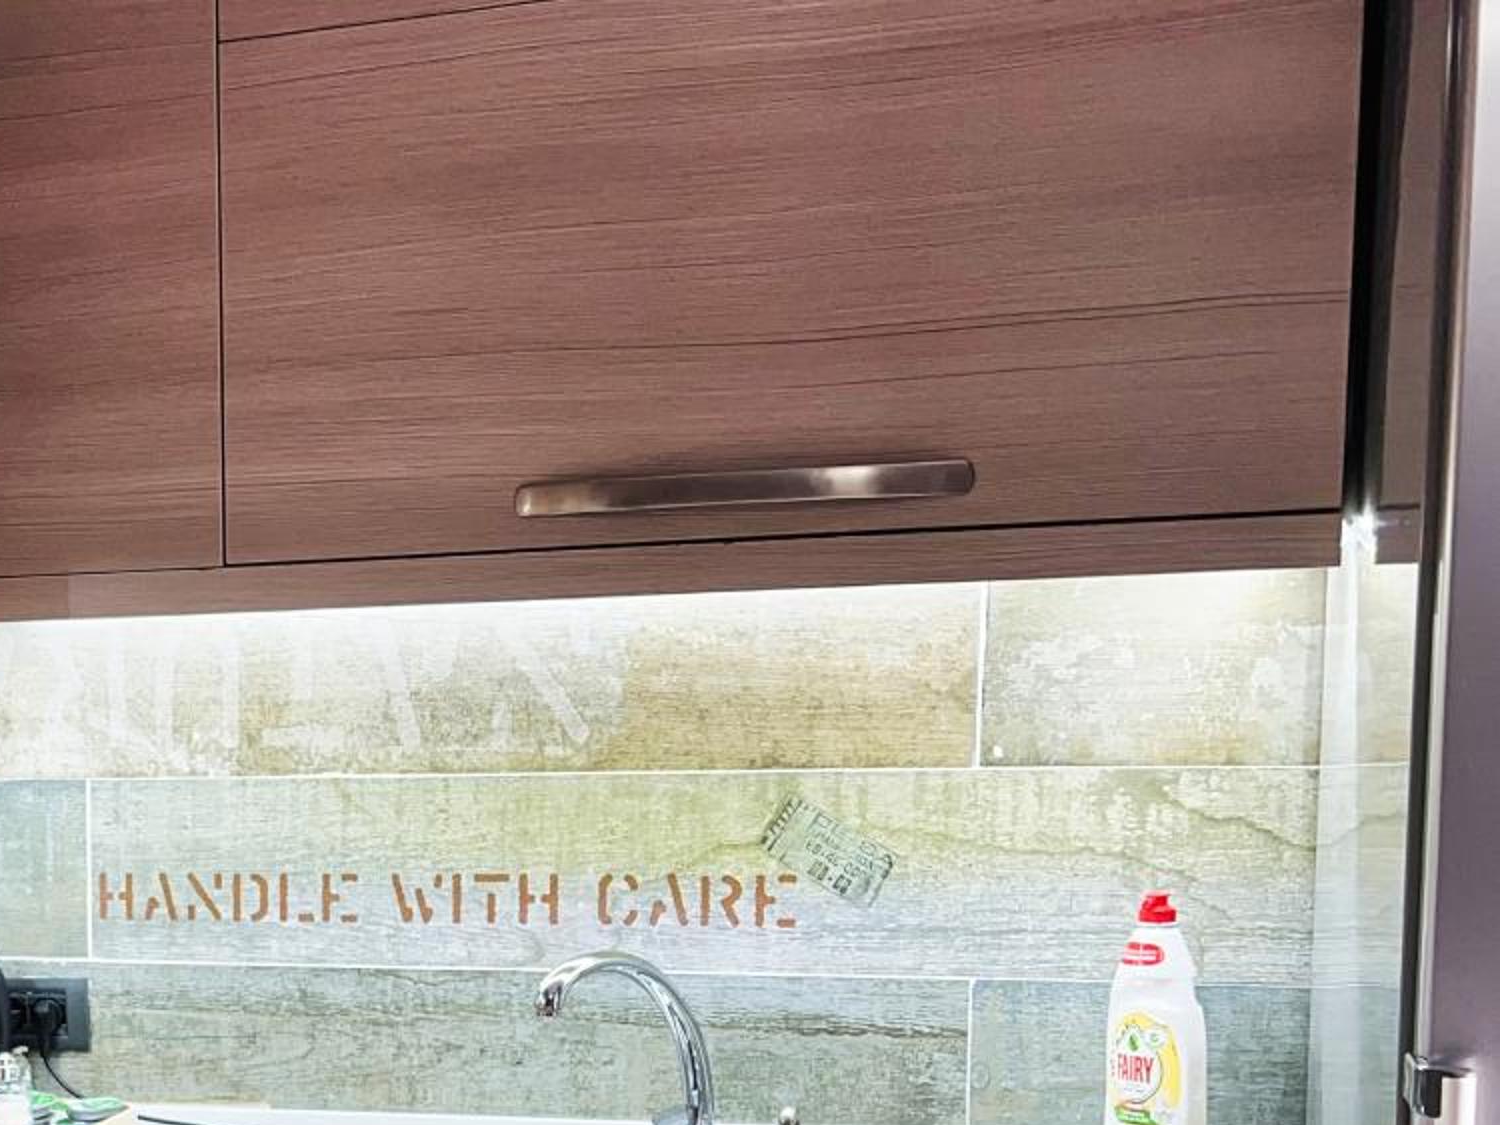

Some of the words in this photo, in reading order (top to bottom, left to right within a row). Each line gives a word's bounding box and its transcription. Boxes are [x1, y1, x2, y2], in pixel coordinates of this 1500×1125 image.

[99, 872, 358, 923] HANDLE
[391, 872, 560, 925] WITH
[598, 872, 798, 927] CARE
[1117, 1053, 1154, 1085] FAIRY
